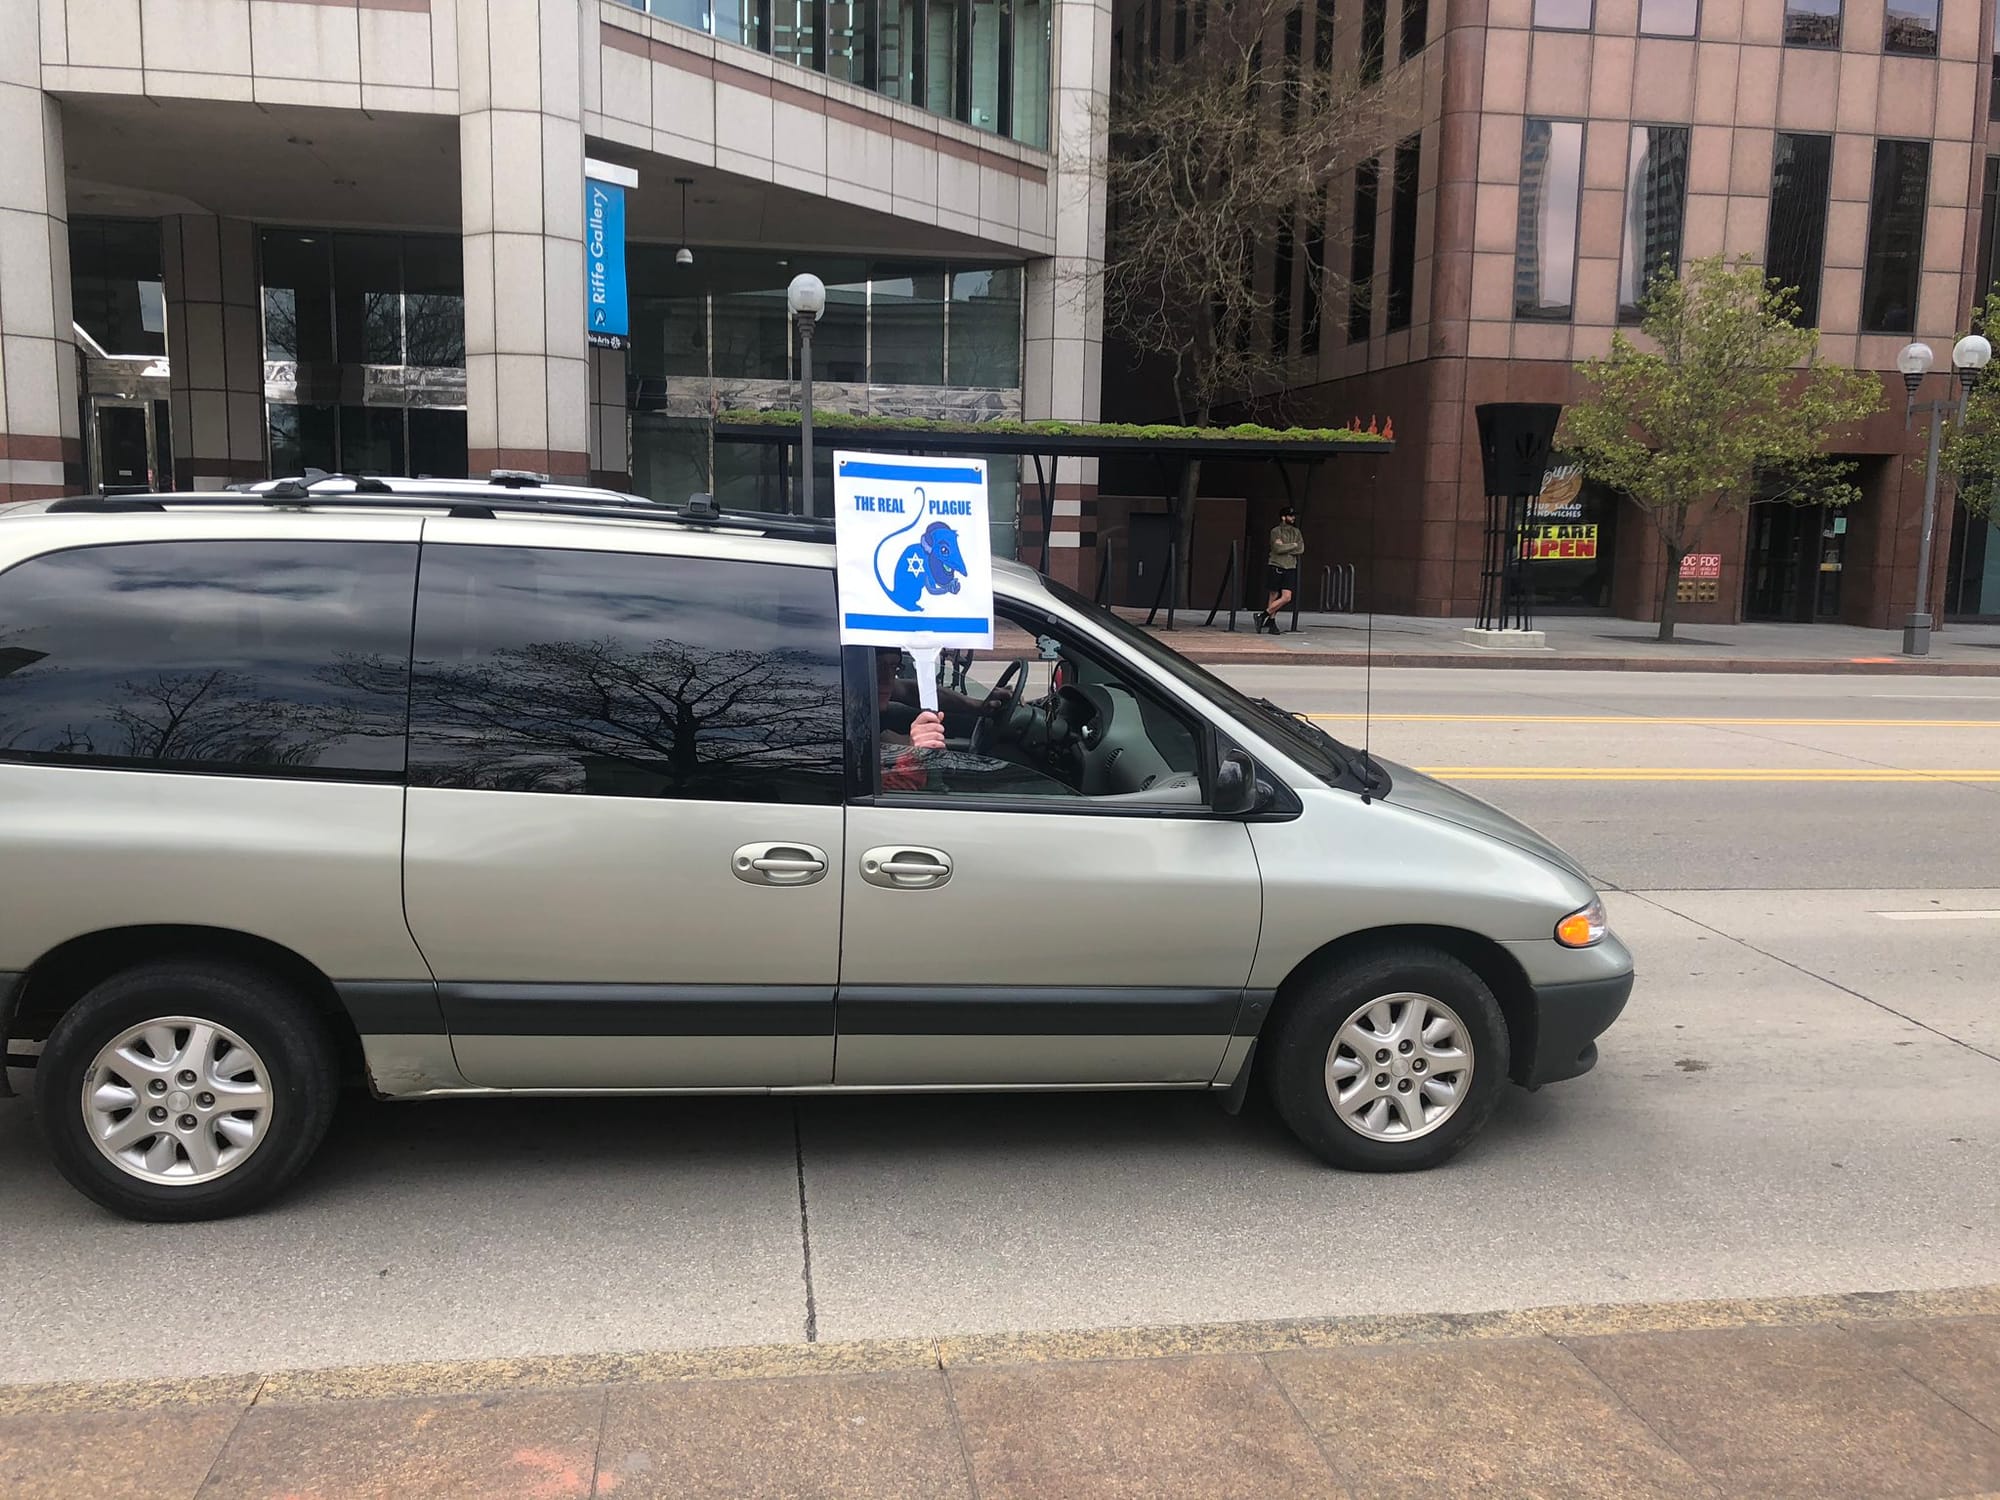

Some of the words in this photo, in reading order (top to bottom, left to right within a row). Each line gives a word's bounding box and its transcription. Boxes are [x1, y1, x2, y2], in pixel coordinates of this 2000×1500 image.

[590, 187, 608, 259] Gallery
[592, 262, 606, 304] Riffe
[854, 495, 875, 512] THE
[877, 497, 905, 514] REAL
[929, 500, 972, 516] PLAGUE
[1557, 526, 1595, 539] ARE
[1522, 539, 1595, 557] OPEN
[1680, 556, 1697, 566] DC
[1700, 556, 1719, 567] FDC
